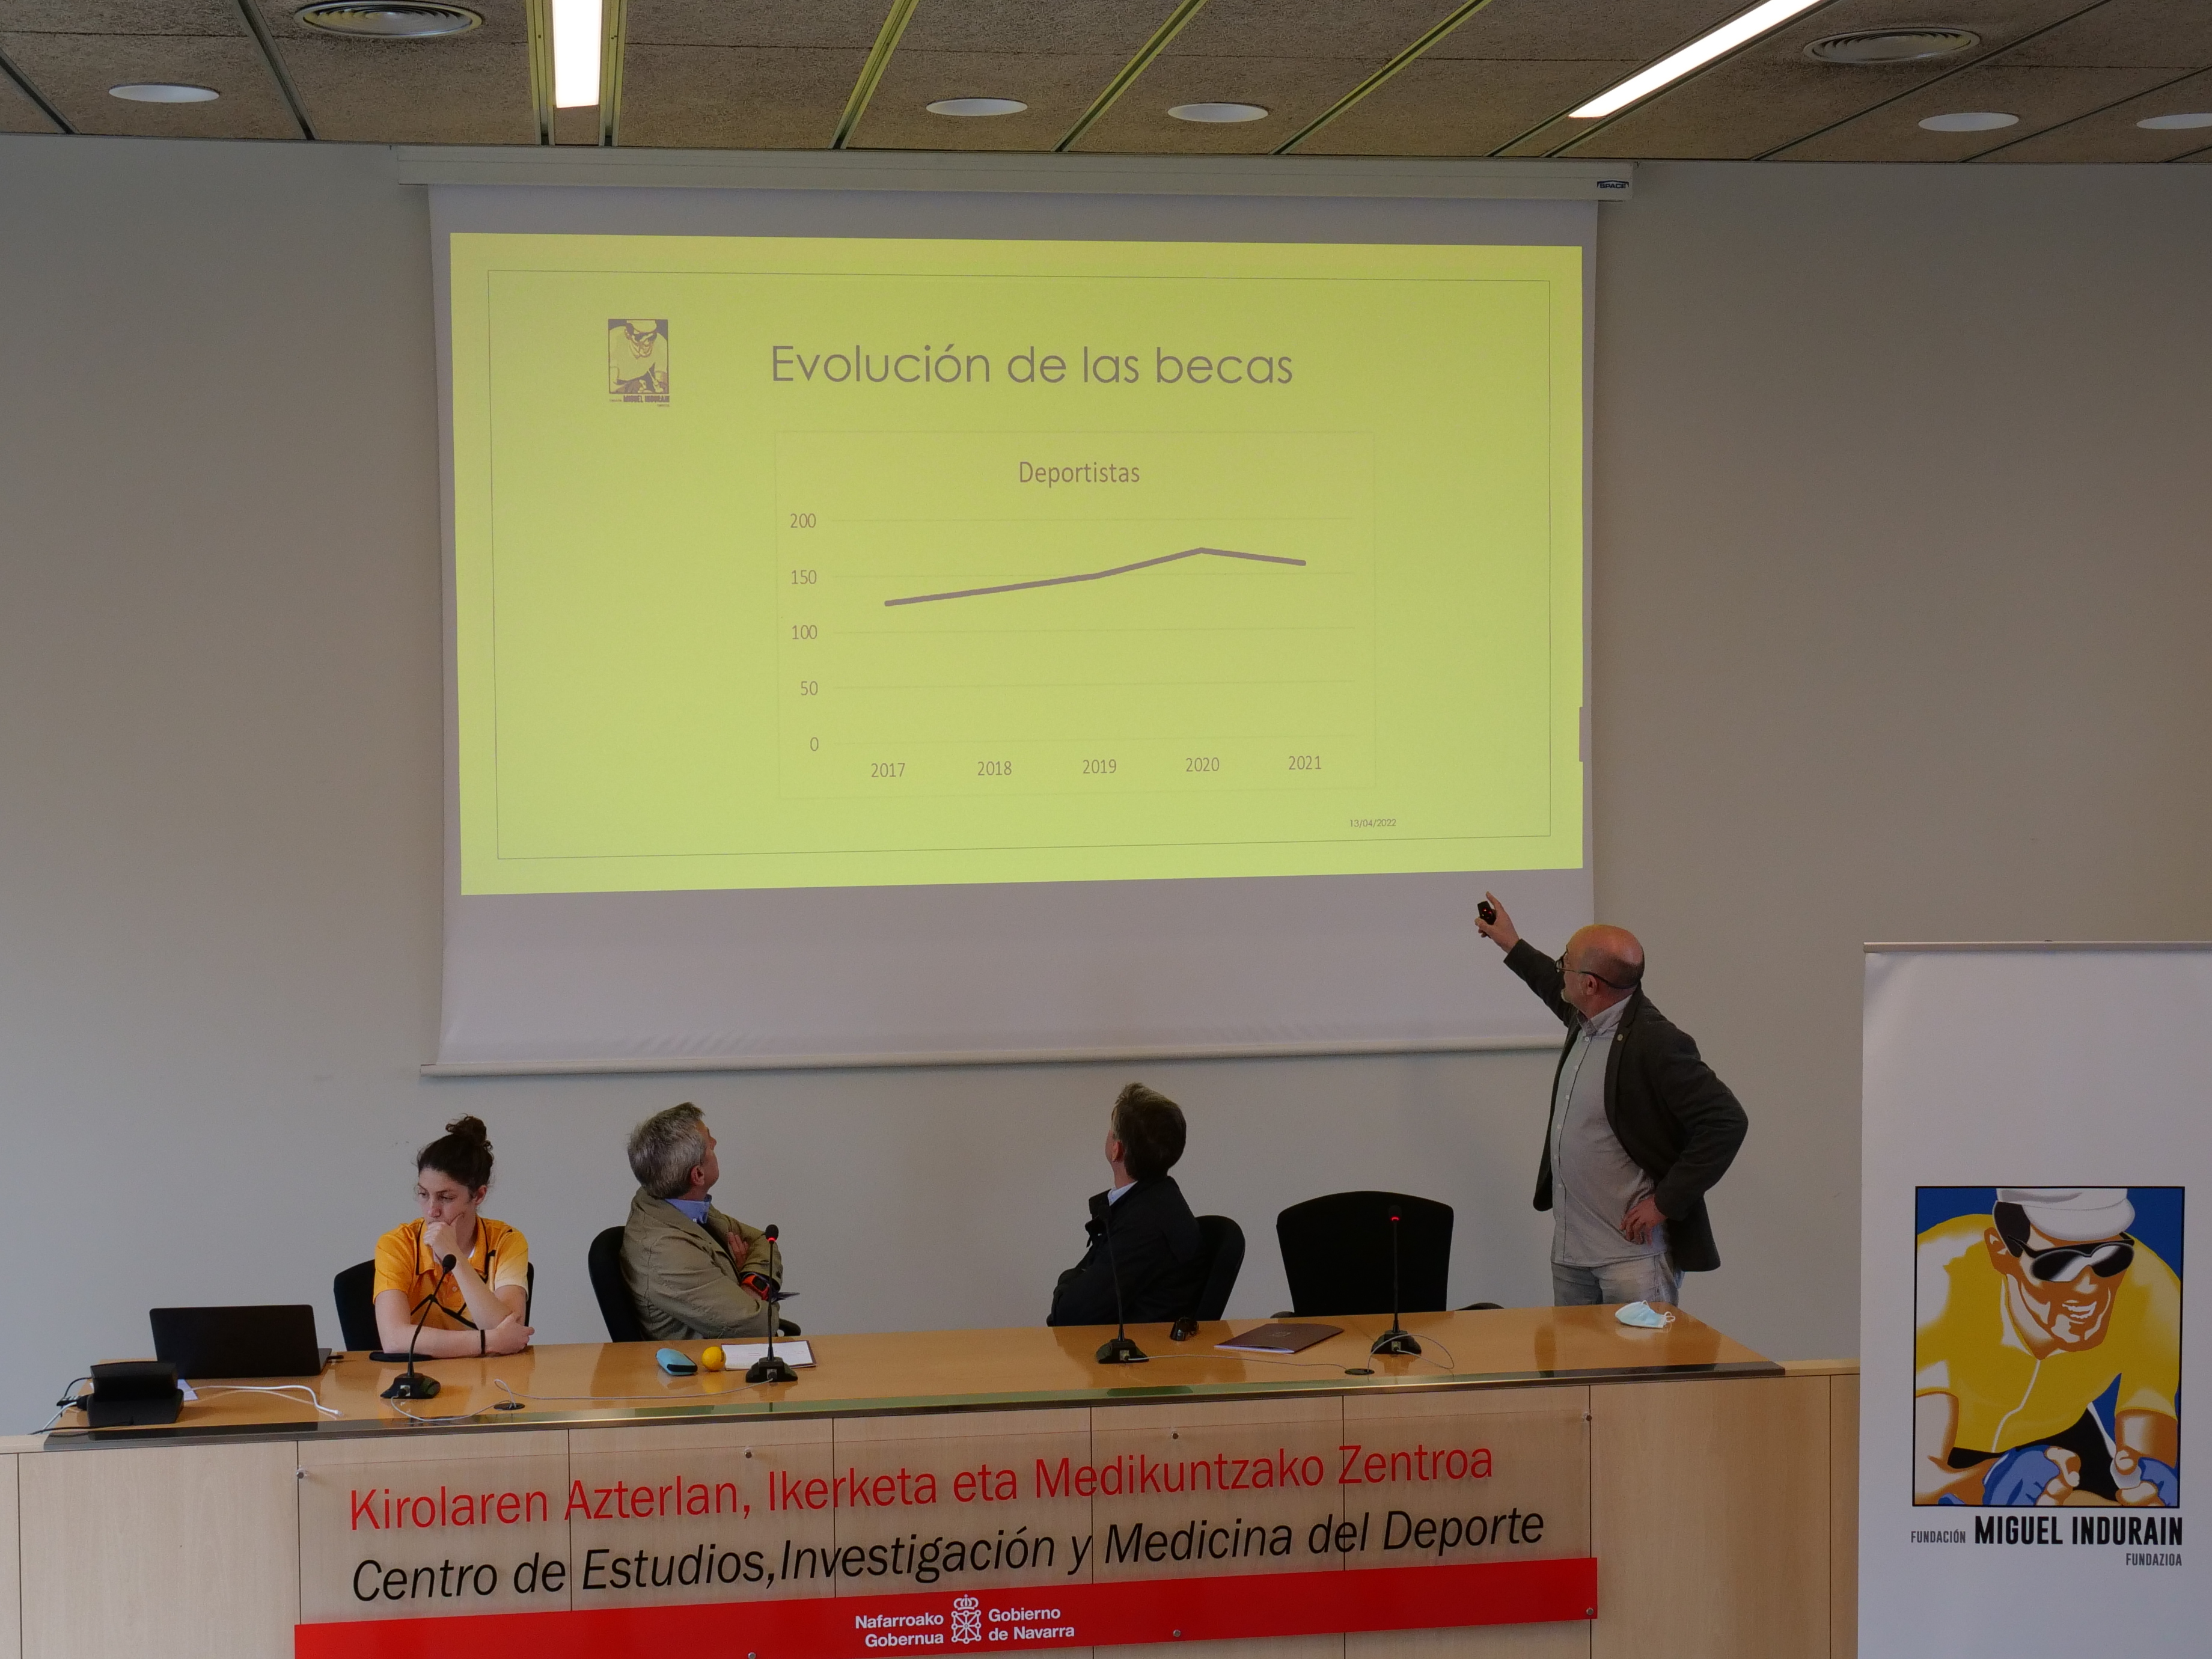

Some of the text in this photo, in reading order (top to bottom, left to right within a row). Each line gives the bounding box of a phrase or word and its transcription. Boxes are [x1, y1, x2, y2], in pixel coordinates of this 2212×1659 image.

[772, 343, 1292, 384] Evolución de las becas
[1019, 461, 1140, 488] Deportistas
[790, 513, 816, 528] 200
[792, 569, 817, 585] 150
[792, 625, 817, 640] 100
[801, 680, 818, 696] 50
[810, 736, 819, 752] 0
[871, 755, 1322, 778] 2017 2018 2019 2020 2021
[1349, 819, 1397, 828] 13/04/2022
[351, 1444, 1492, 1530] Kirolaren Azterlan, Ikerketa eta Medikuntzako Zentroa
[1911, 1515, 2183, 1545] FUNDACIÓN MIGUEL INDURAIN
[353, 1559, 498, 1601] Centro
[513, 1552, 566, 1594] de
[1068, 1534, 1093, 1575] y
[1105, 1518, 1292, 1563] Medicina
[1309, 1512, 1369, 1553] del
[1383, 1508, 1544, 1557] Deporte
[2126, 1553, 2182, 1566] FUNDAZIOA
[855, 1612, 944, 1629] Nafarroako
[988, 1607, 1061, 1622] Gobierno
[865, 1632, 944, 1648] Gobernua
[988, 1626, 1075, 1641] de Navarra
